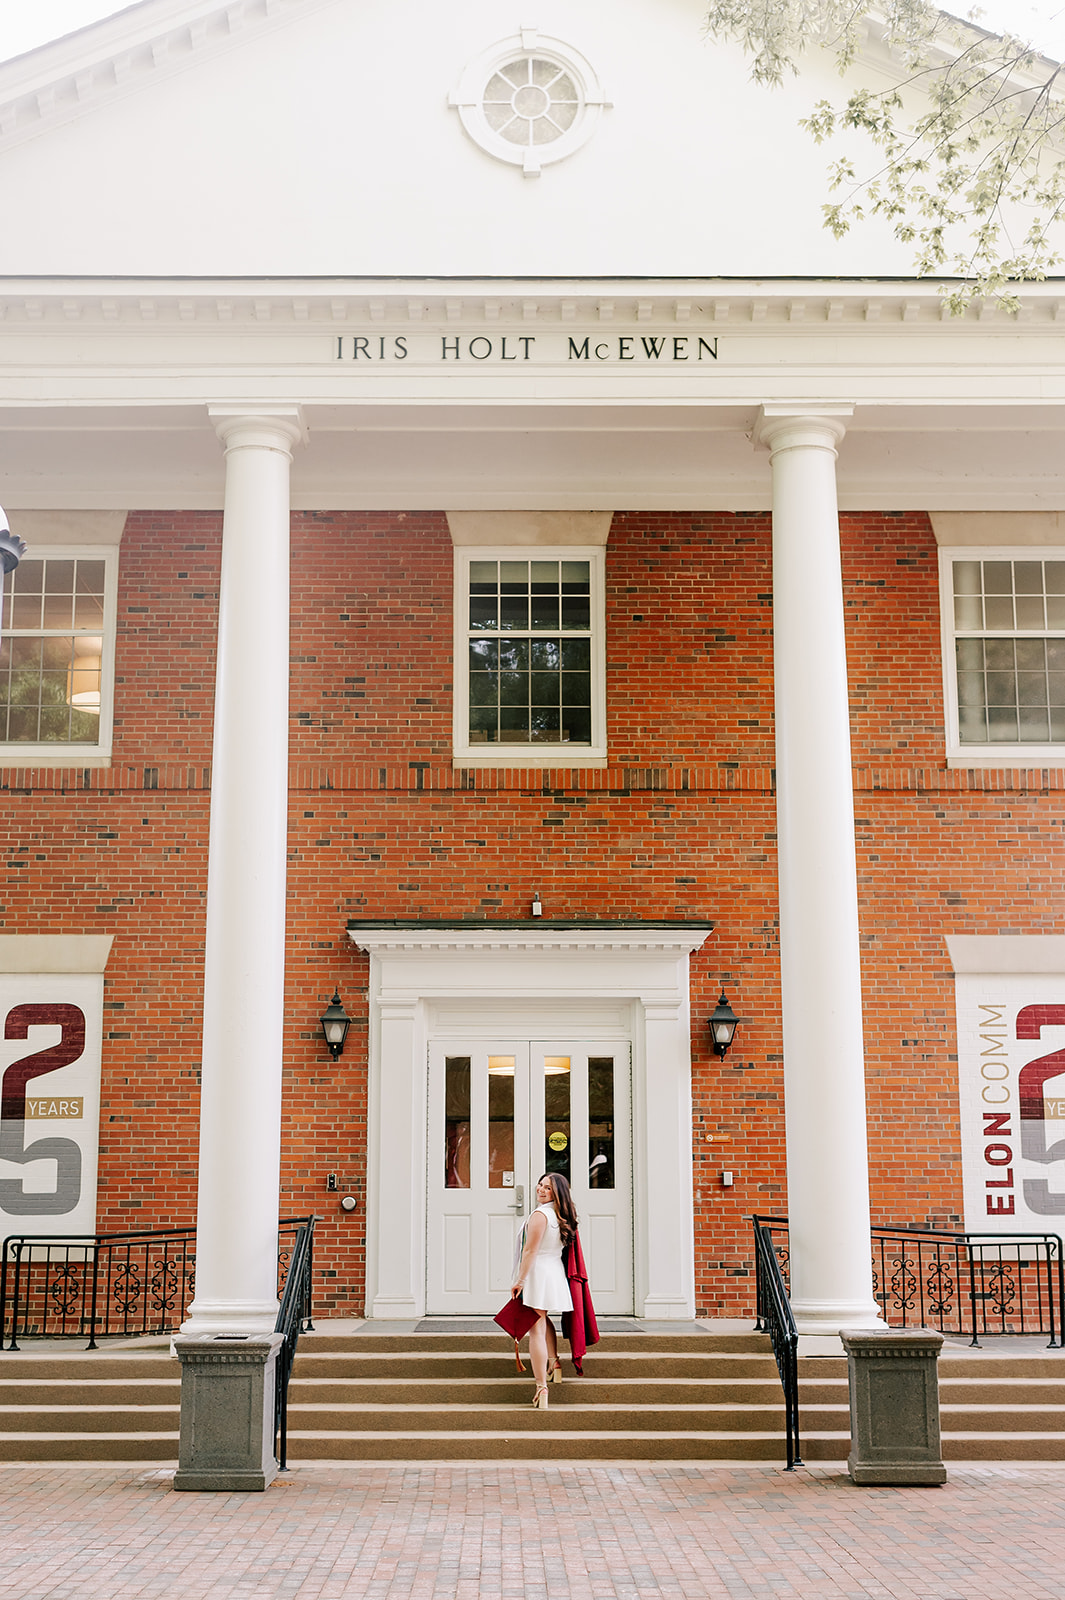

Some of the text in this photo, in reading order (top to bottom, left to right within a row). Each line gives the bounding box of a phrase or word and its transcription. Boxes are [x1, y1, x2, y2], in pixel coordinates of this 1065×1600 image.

[336, 336, 720, 361] IRIS HOLT McEWEN
[28, 1101, 80, 1116] YEARS
